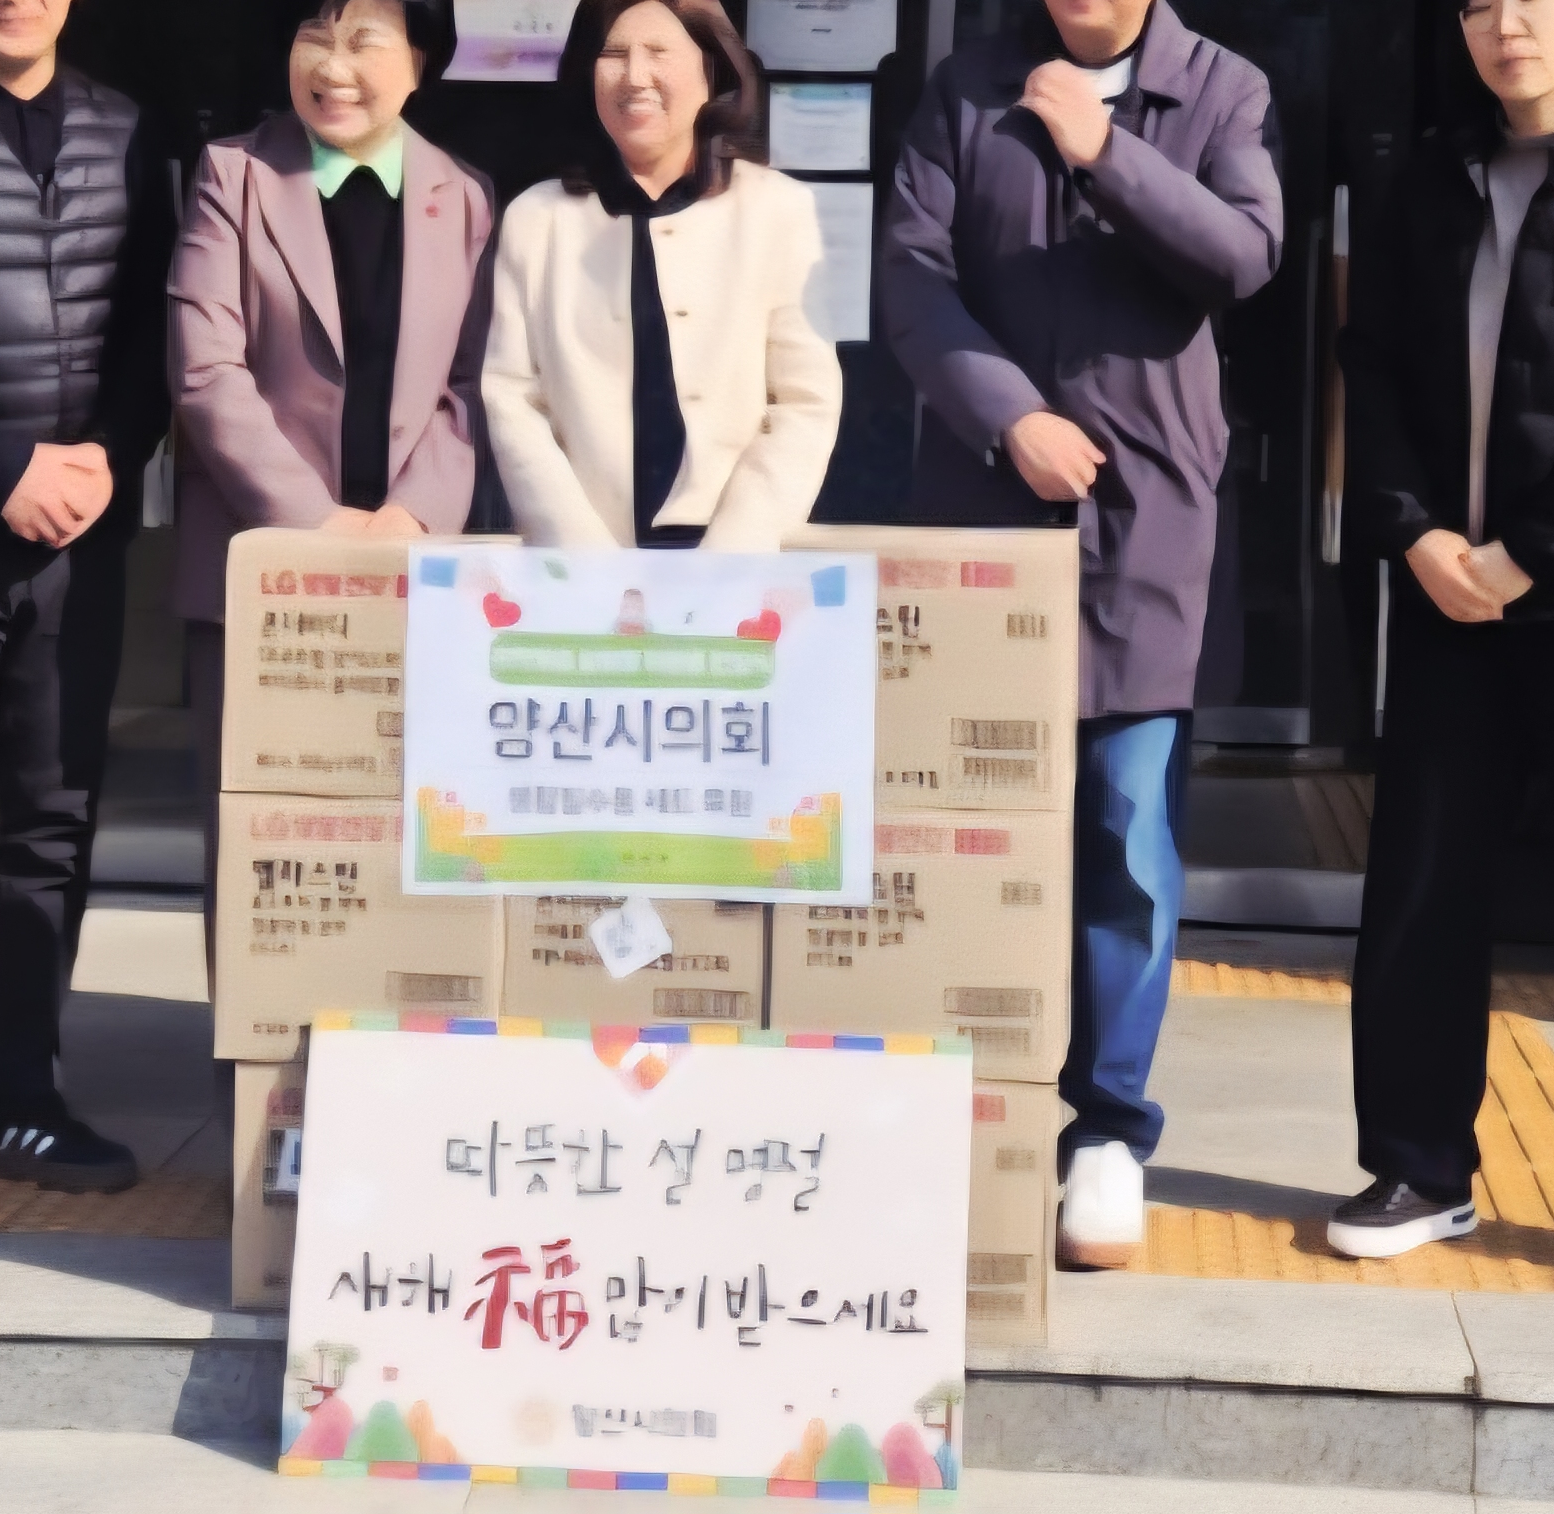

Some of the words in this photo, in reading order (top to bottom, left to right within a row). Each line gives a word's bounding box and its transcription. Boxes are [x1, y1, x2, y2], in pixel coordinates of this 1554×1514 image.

[489, 698, 769, 766] 양산시의회
[447, 1120, 624, 1197] 따뜻한
[649, 1128, 701, 1205] 설
[328, 1251, 452, 1314] 새해
[463, 1237, 589, 1350] 福
